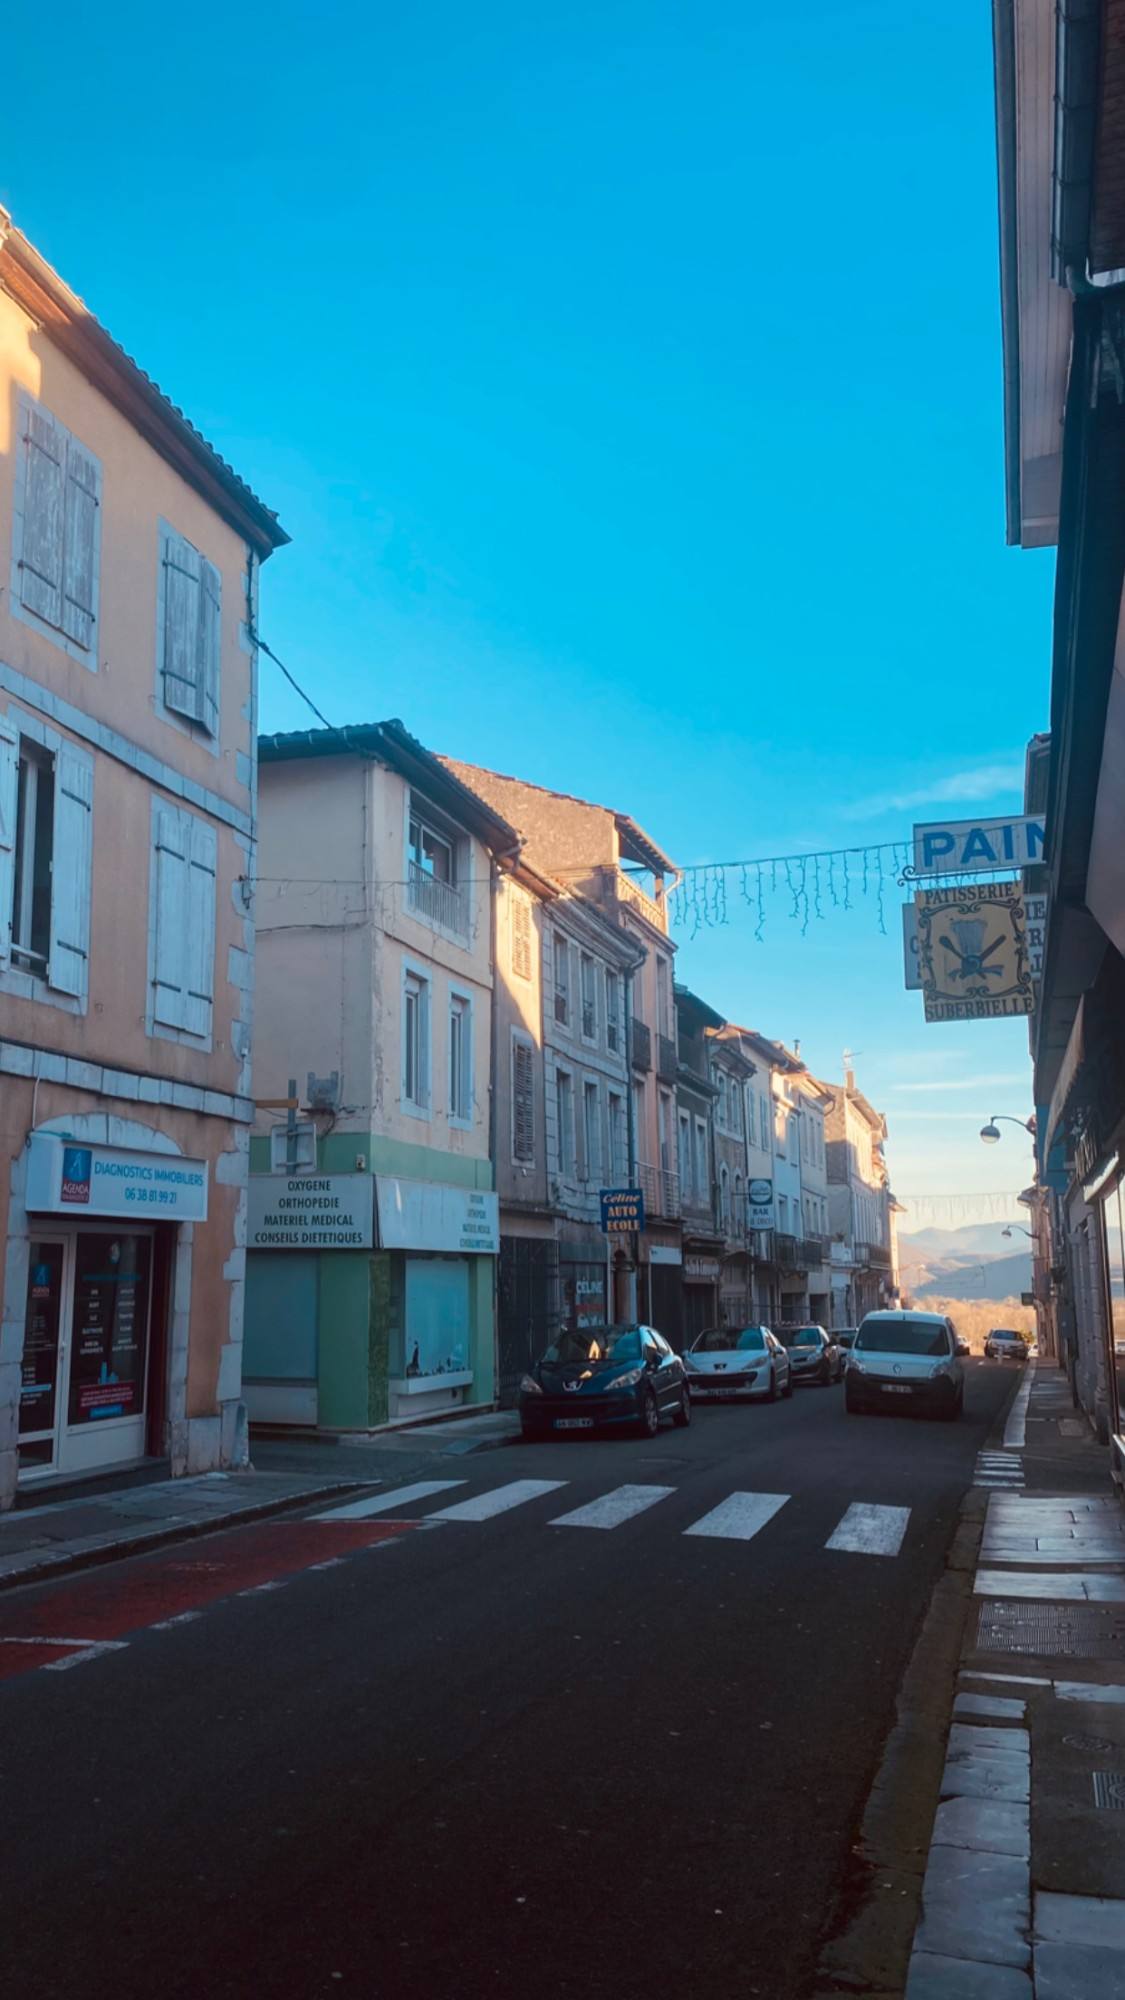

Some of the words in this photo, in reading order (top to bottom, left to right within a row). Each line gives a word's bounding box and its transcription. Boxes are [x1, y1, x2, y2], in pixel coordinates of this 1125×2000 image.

[924, 882, 1015, 905] PATISSERIE
[925, 997, 1034, 1020] SUBERBIELLE
[94, 1161, 153, 1180] DIAGNOSTICS
[154, 1171, 204, 1187] IMMOBILIERS
[62, 1182, 90, 1195] AGENDA
[287, 1179, 331, 1192] OXYGENE
[124, 1187, 136, 1201] 06
[137, 1188, 148, 1201] 38
[158, 1190, 169, 1203] 99
[278, 1197, 340, 1209] ORTHOPEDIE
[607, 1205, 638, 1217] AUTO
[263, 1214, 309, 1226] MATERIEL
[310, 1214, 354, 1226] MEDICAL
[606, 1219, 641, 1232] ECOLE
[254, 1232, 299, 1244] CONSEILS
[301, 1232, 363, 1245] DIETETIQUES
